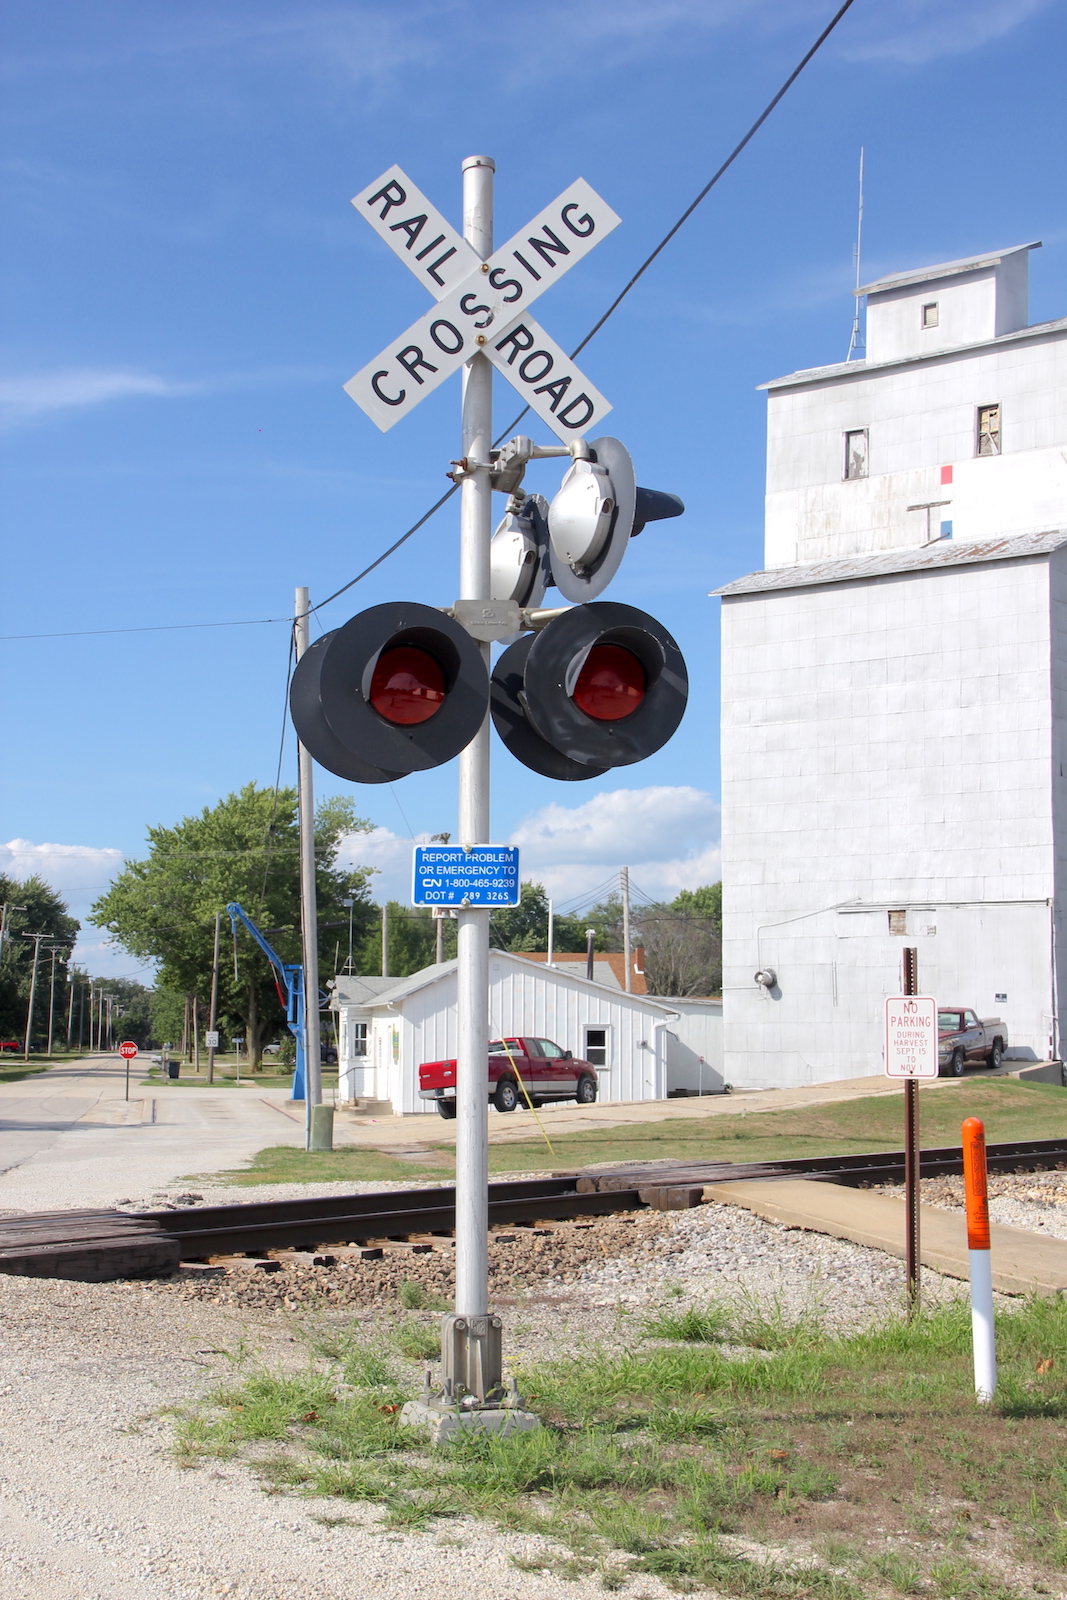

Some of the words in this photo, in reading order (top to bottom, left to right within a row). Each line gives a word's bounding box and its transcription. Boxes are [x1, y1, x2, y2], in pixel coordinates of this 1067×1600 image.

[366, 179, 457, 287] RAIL
[494, 323, 594, 429] ROAD
[371, 203, 595, 406] CROSSING
[422, 853, 463, 862] REPORT
[465, 853, 514, 862] PROBLEM
[419, 866, 434, 875] OR
[436, 866, 500, 875] EMERGENCY
[502, 866, 516, 875] TO
[422, 879, 442, 887] CN
[445, 879, 515, 888] 1-800-465-9239
[425, 891, 446, 900] DOT
[448, 891, 455, 900] #
[463, 892, 481, 900] 289
[903, 1003, 918, 1014] NO
[891, 1016, 931, 1027] PARKING
[896, 1031, 925, 1039] DURING
[893, 1039, 929, 1047] HARVEST
[120, 1047, 137, 1055] STOP
[896, 1047, 915, 1055] SEPT
[918, 1047, 926, 1055] 15
[900, 1064, 916, 1072] NOV
